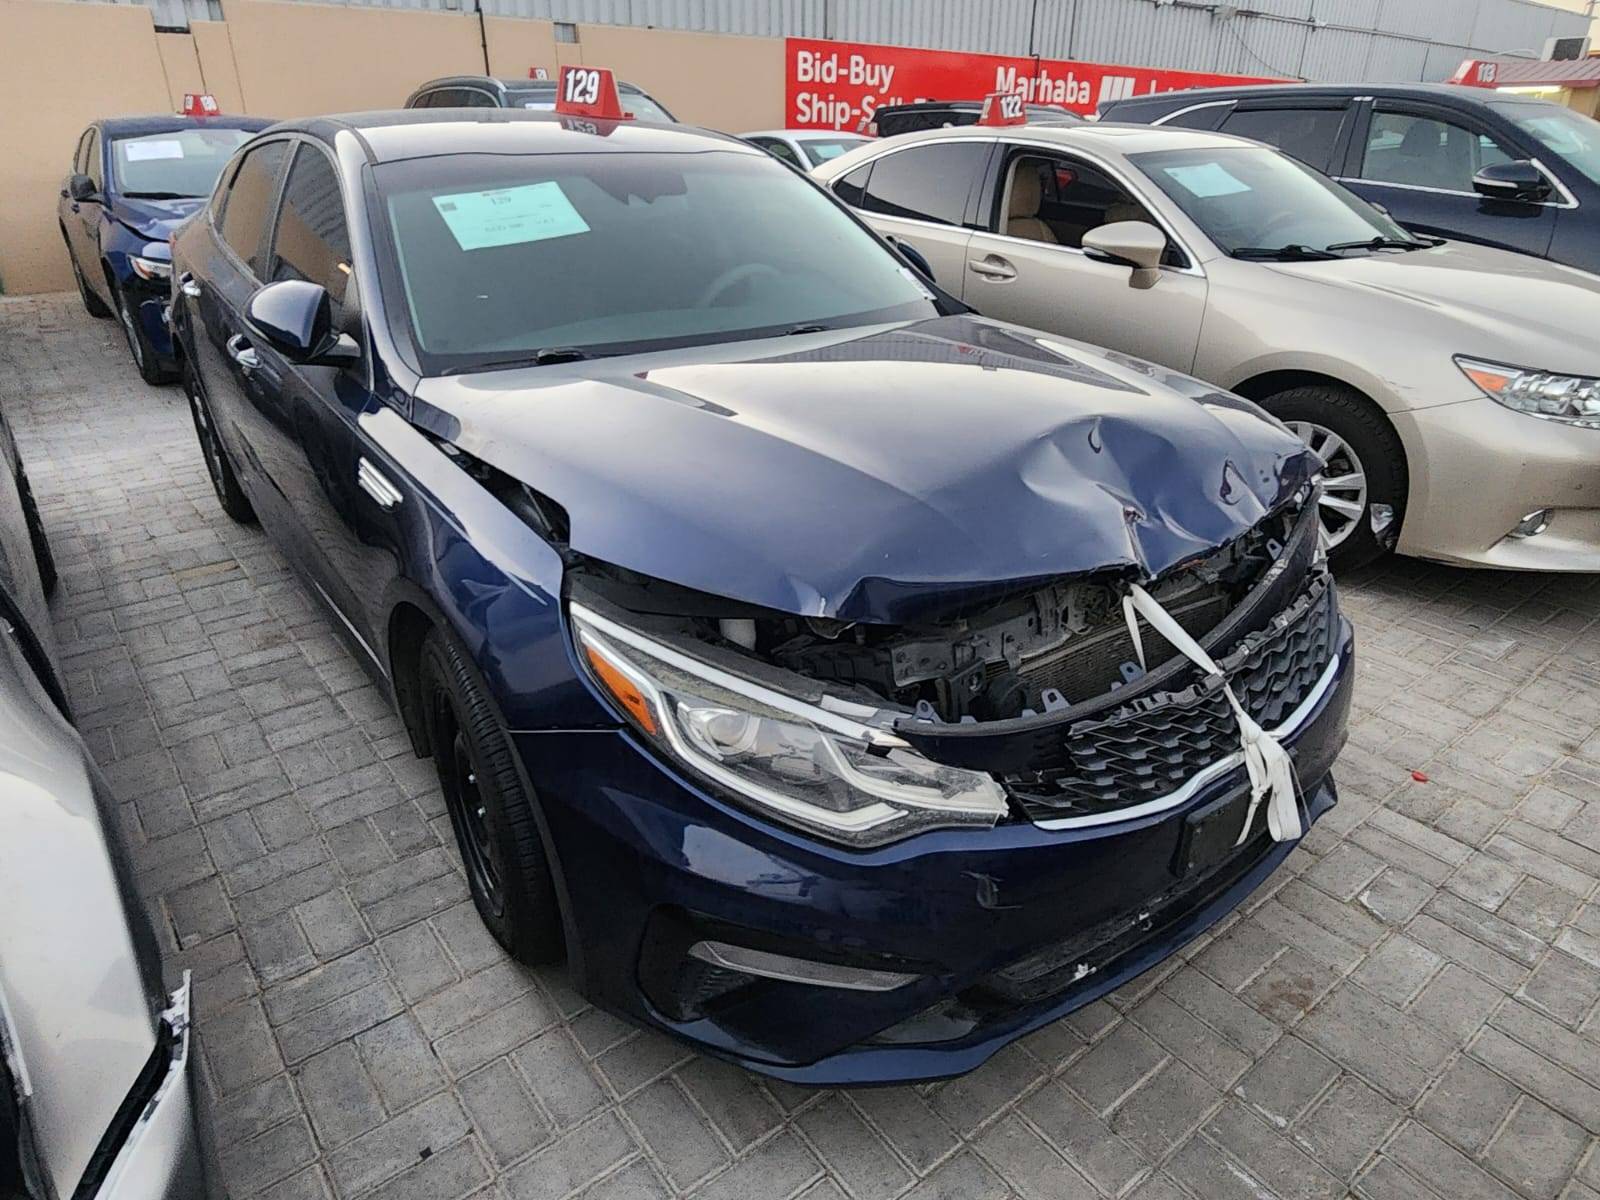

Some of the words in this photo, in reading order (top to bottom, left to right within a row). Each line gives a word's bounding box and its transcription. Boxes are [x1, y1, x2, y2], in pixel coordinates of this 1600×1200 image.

[565, 69, 600, 105] 129
[797, 50, 895, 94] Bid-Buy
[996, 65, 1091, 105] Marhaba
[796, 91, 903, 131] Ship-S
[1000, 94, 1024, 119] 122
